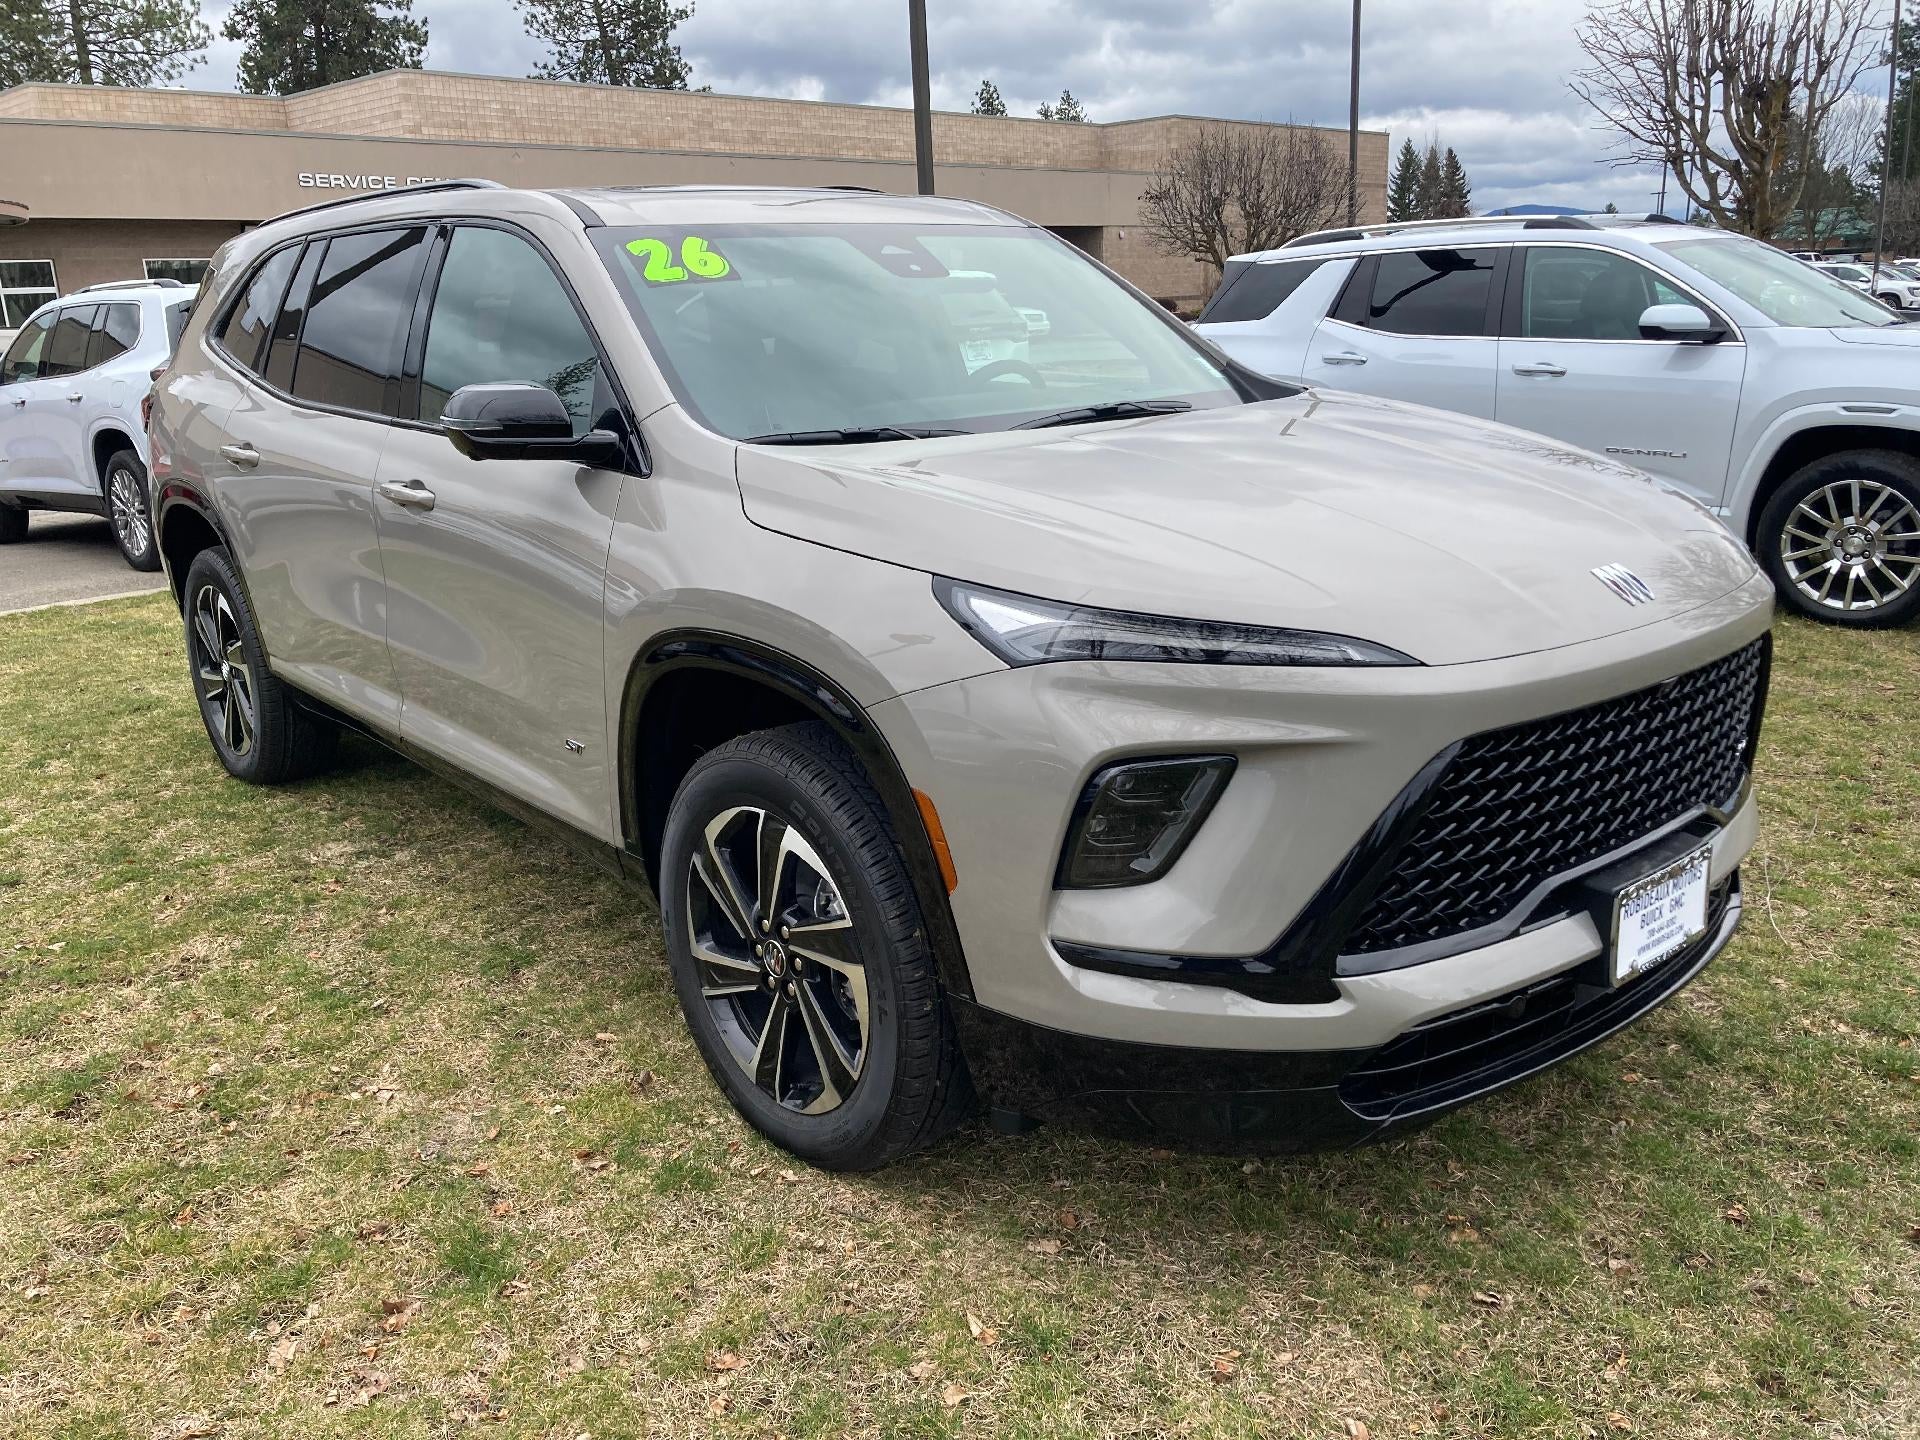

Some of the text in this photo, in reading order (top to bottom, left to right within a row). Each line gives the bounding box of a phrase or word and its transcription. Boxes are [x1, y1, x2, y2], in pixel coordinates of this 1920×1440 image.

[299, 173, 396, 189] SERVICE
[625, 236, 730, 282] 26
[1605, 446, 1687, 459] DENALI
[1623, 864, 1703, 920] ROBIDEAUX MOTORS
[1640, 892, 1685, 929] BUICK GMC
